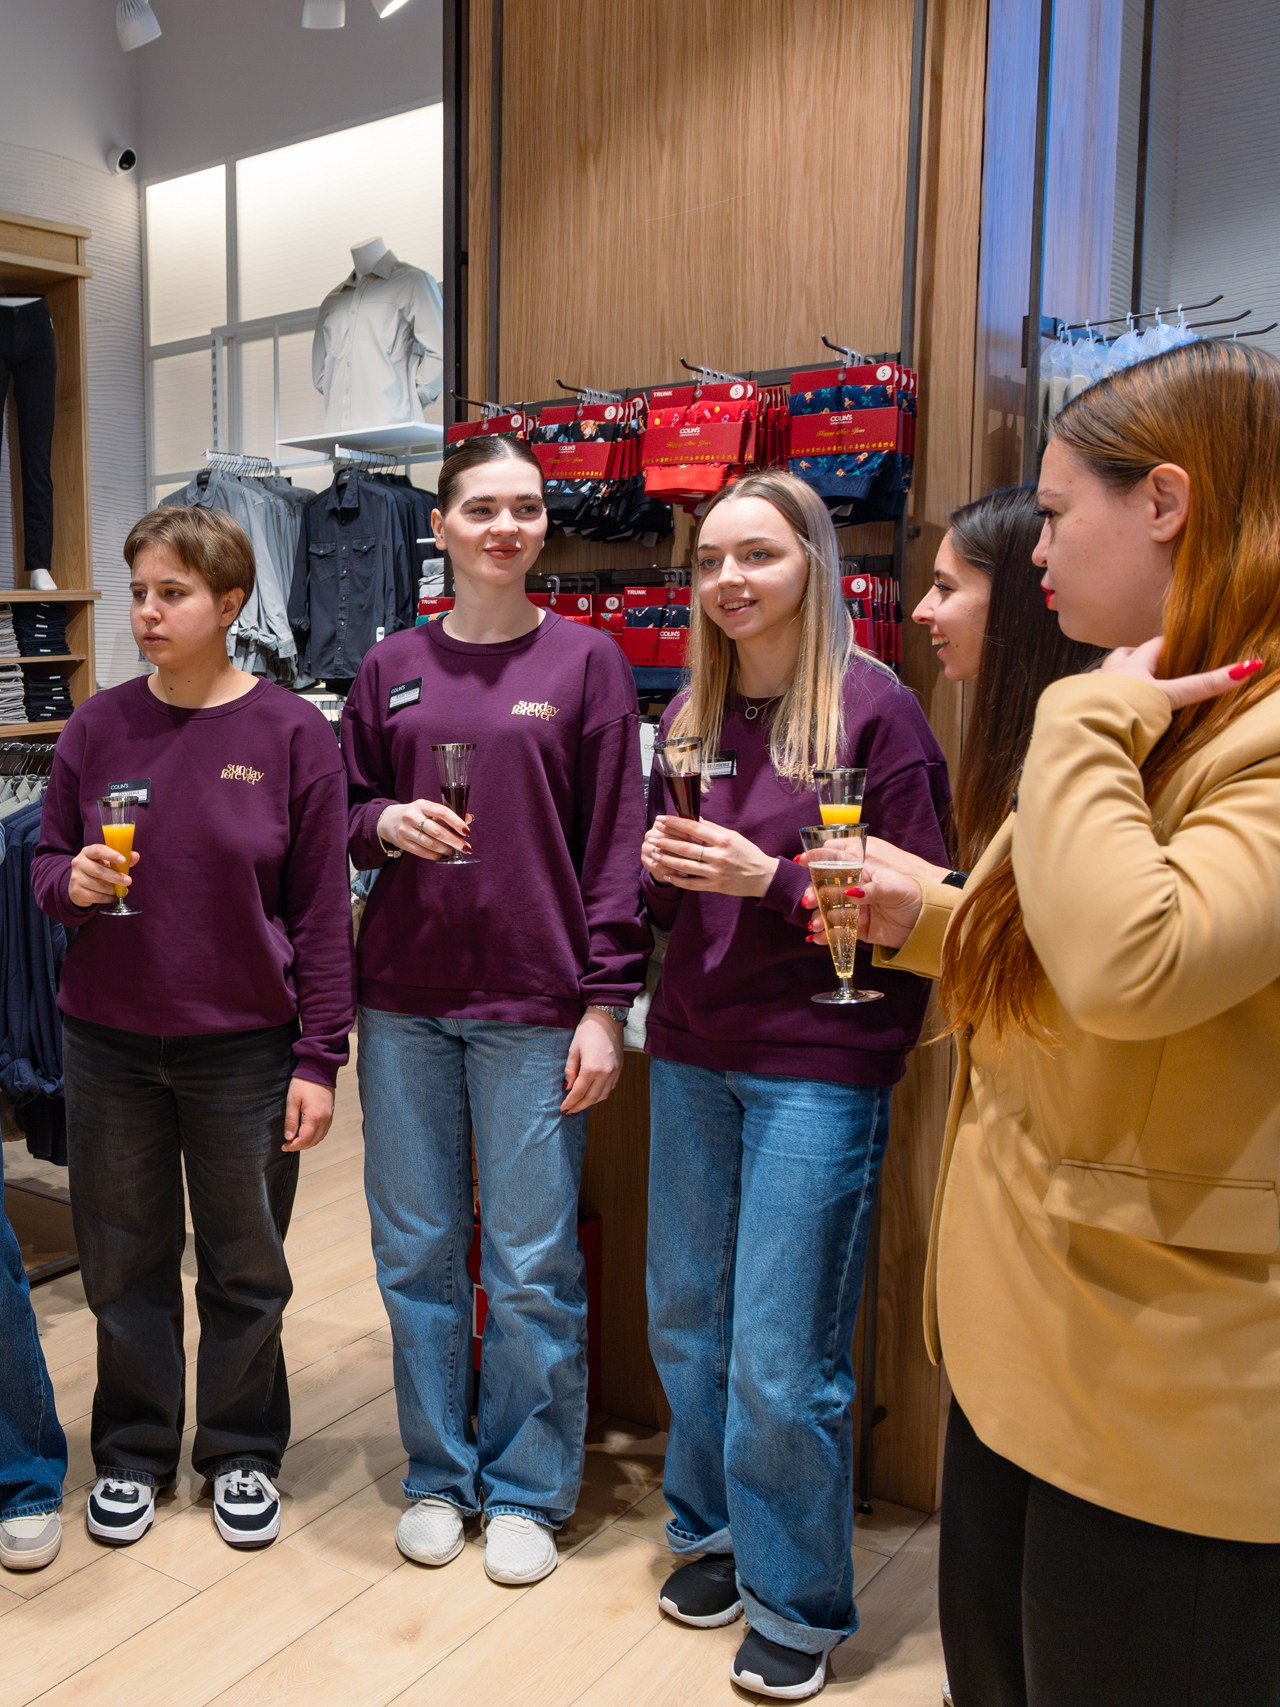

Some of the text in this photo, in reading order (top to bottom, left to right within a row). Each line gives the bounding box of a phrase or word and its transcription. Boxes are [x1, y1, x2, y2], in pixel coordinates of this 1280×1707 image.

[653, 390, 673, 398] TRUNK
[830, 414, 853, 422] COLIN'S
[390, 684, 406, 694] COLIN'S
[511, 704, 549, 721] forever
[518, 700, 560, 717] sunday
[220, 768, 256, 785] forever
[226, 763, 265, 781] sunday
